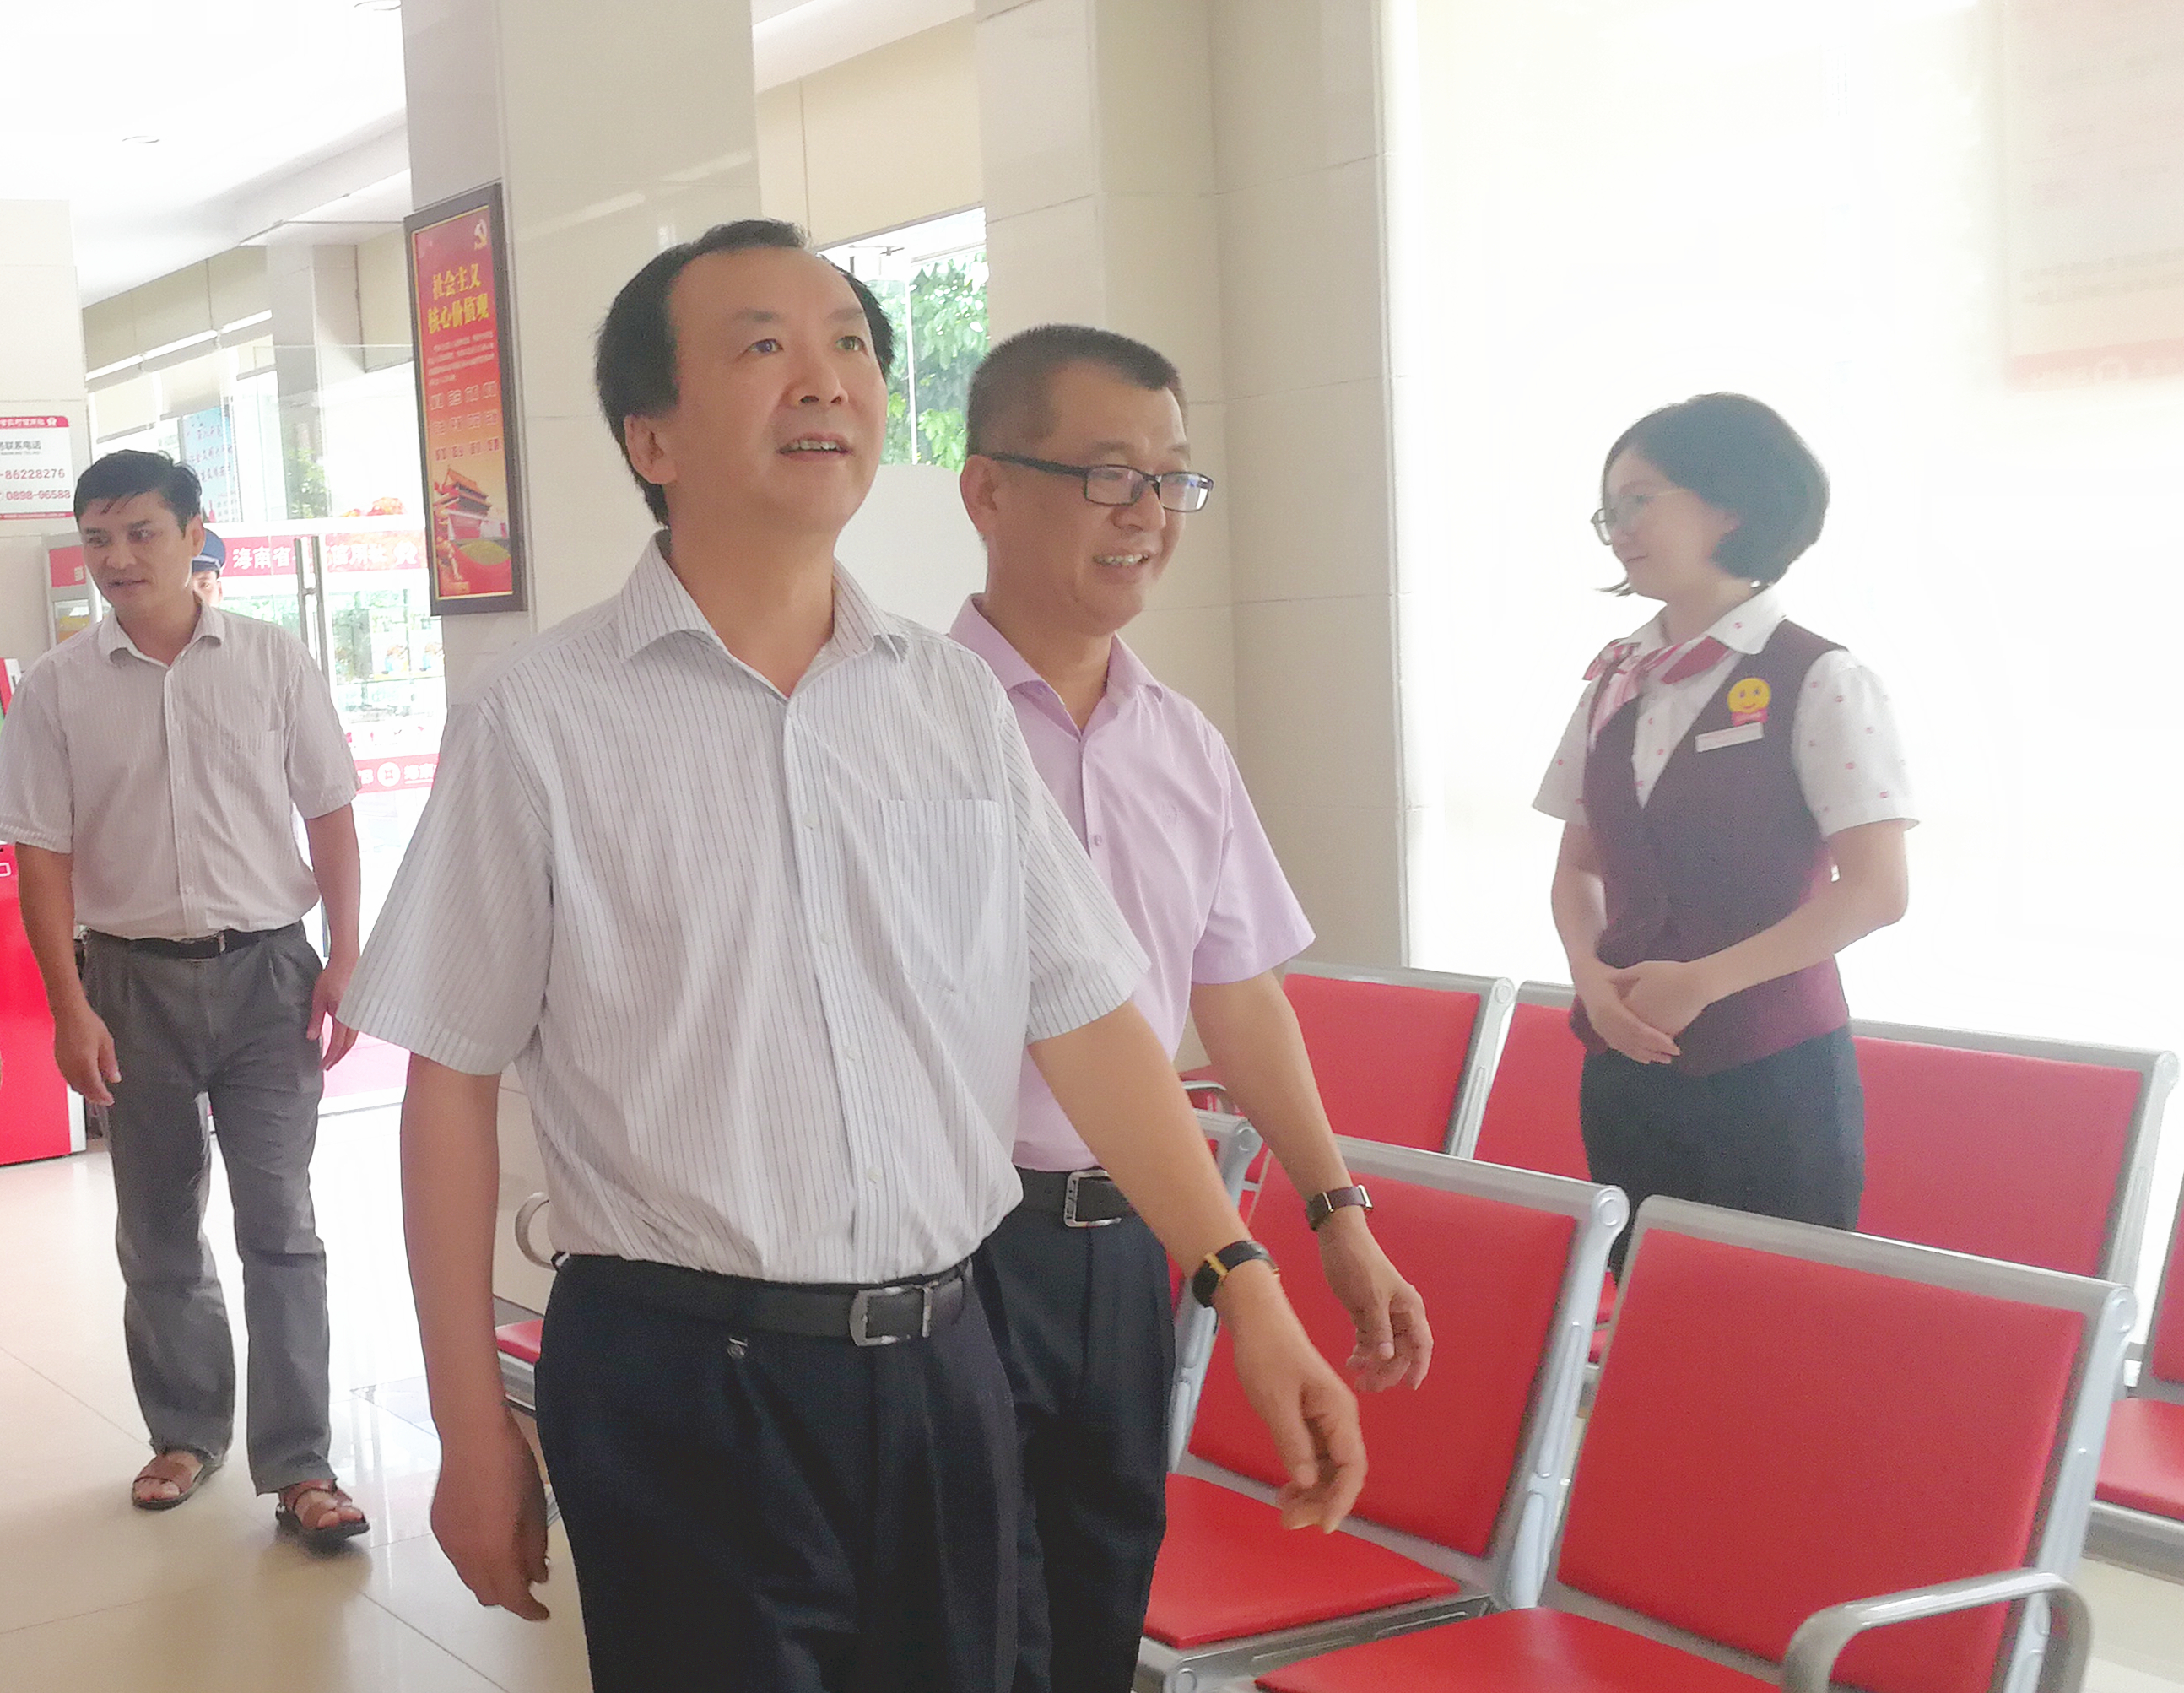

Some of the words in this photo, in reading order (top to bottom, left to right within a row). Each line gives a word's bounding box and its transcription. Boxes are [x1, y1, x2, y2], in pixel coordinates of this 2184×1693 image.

[433, 262, 481, 300] 社会主义
[427, 293, 489, 334] 核心价值观
